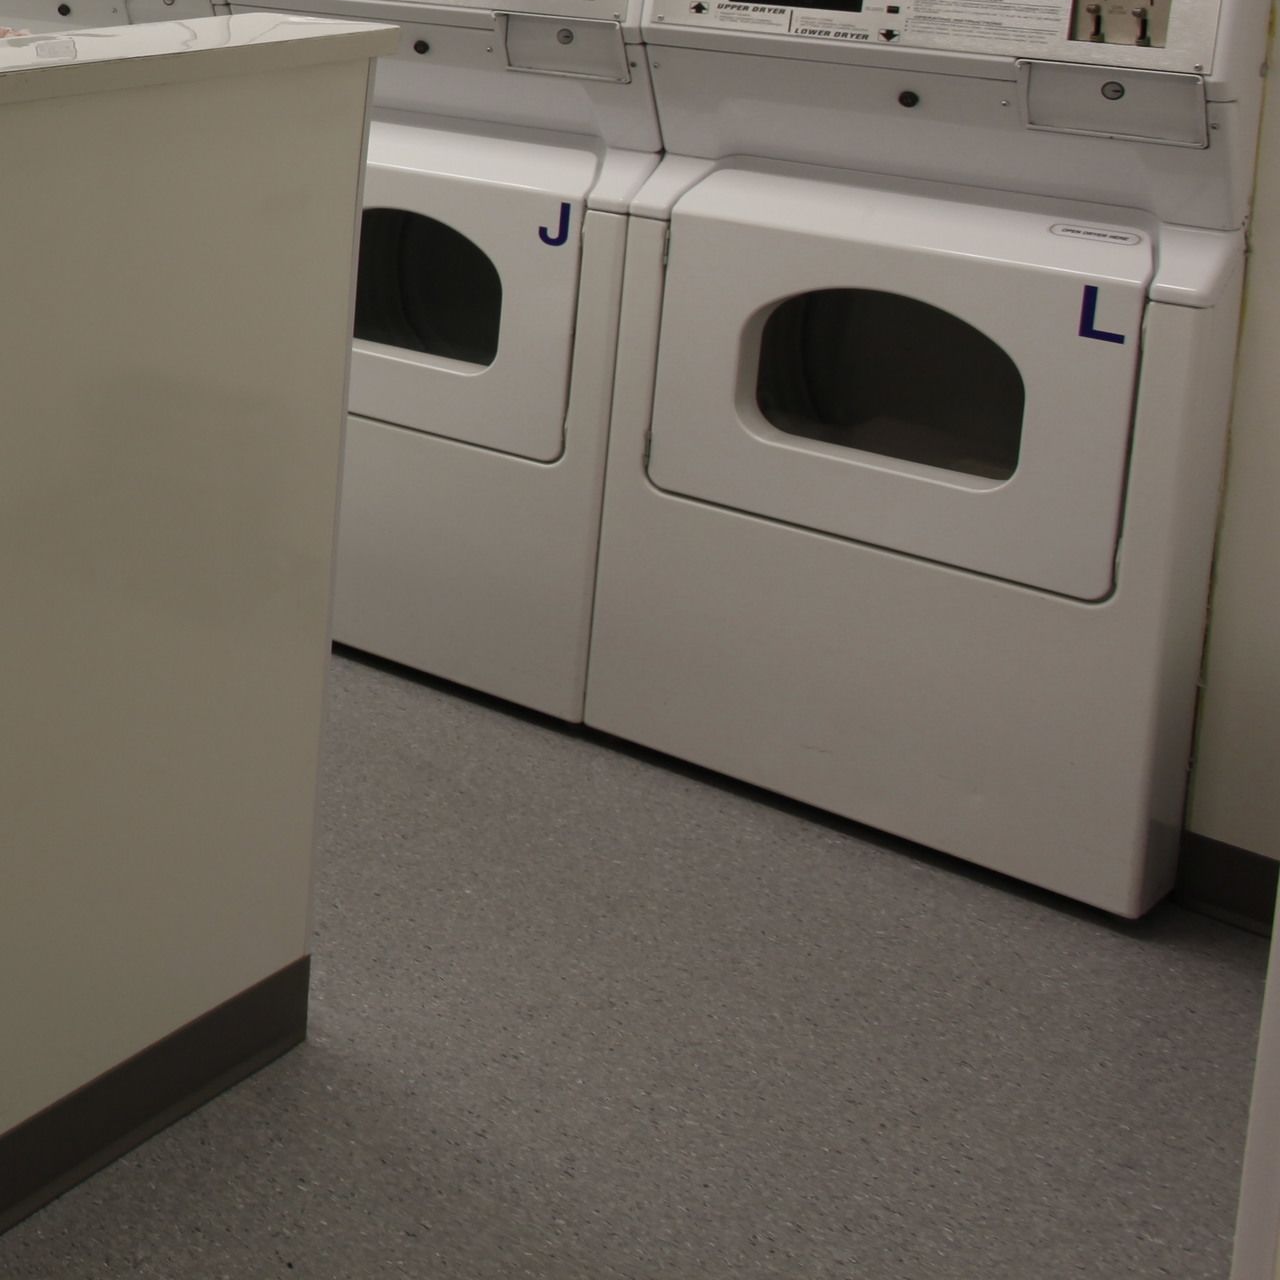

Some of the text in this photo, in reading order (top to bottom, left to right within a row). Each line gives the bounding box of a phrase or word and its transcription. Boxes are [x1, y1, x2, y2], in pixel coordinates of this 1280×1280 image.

[717, 3, 786, 15] UPPER DRYER
[794, 28, 870, 41] LOWER DRYER
[538, 202, 571, 246] J
[1078, 284, 1125, 345] L
